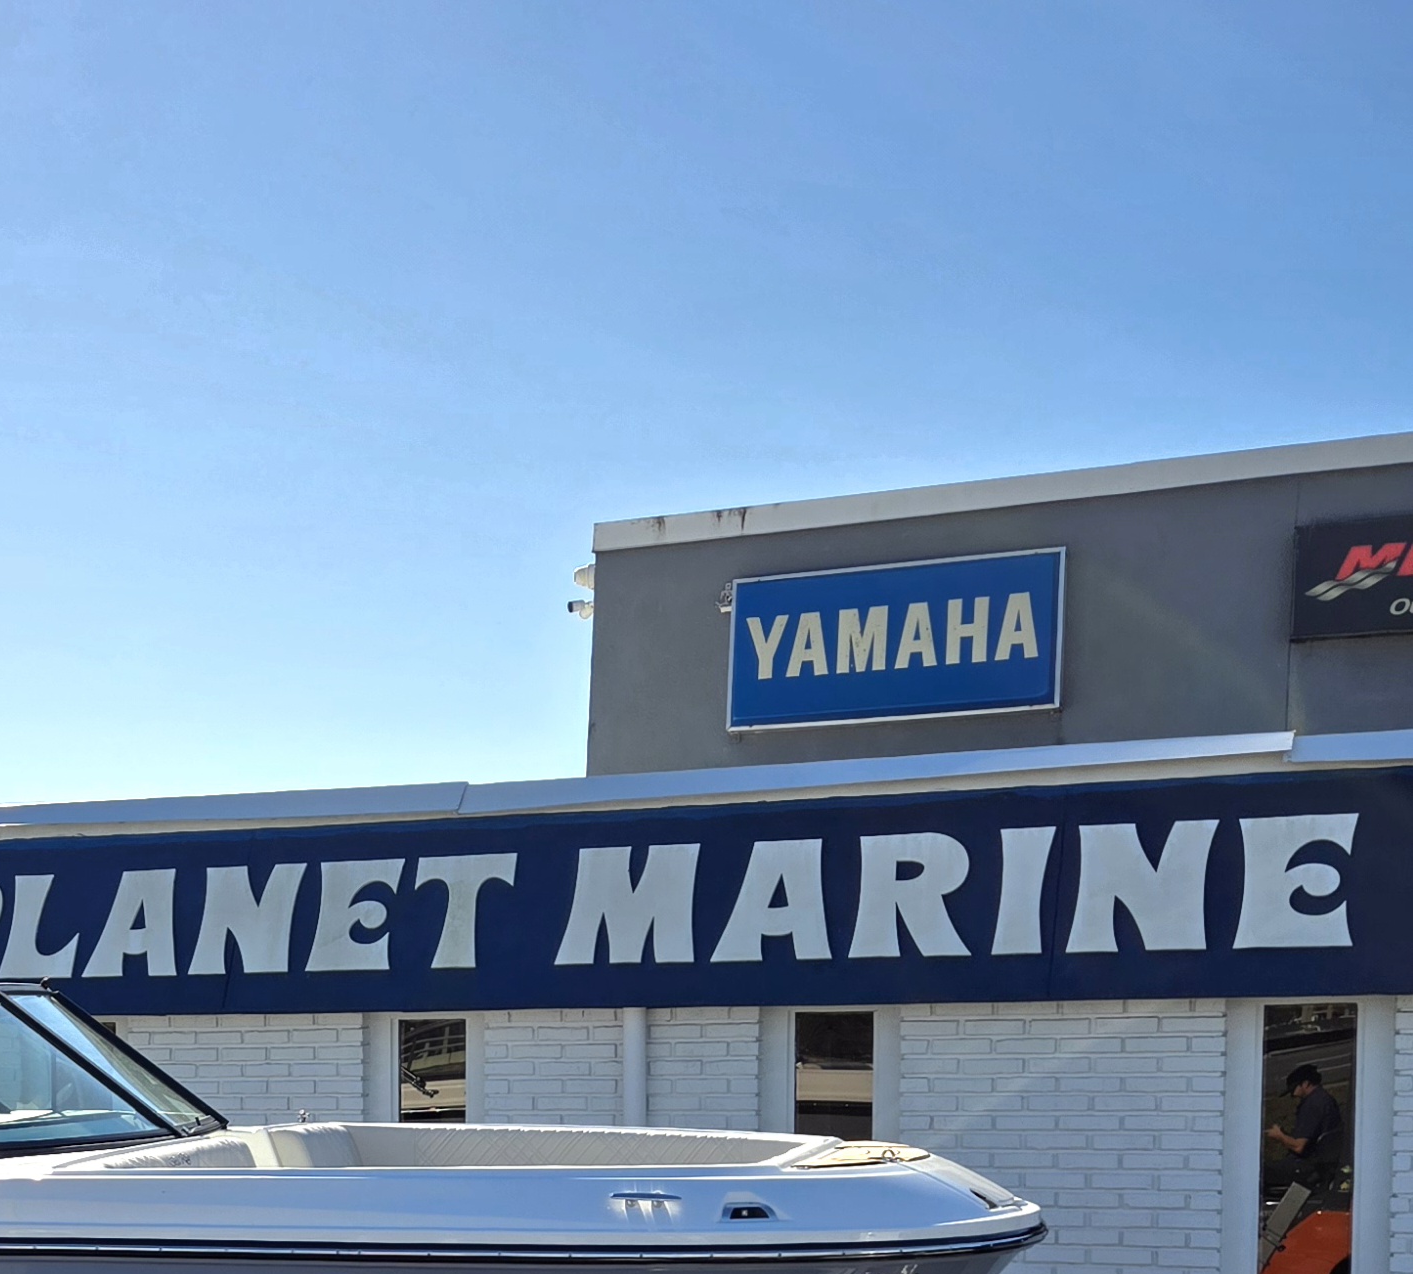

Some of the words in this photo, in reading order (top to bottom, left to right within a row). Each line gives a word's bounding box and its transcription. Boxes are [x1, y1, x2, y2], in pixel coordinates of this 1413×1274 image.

[1335, 542, 1413, 582] M
[746, 592, 1038, 680] YAMAHA
[554, 813, 1360, 965] MARINE
